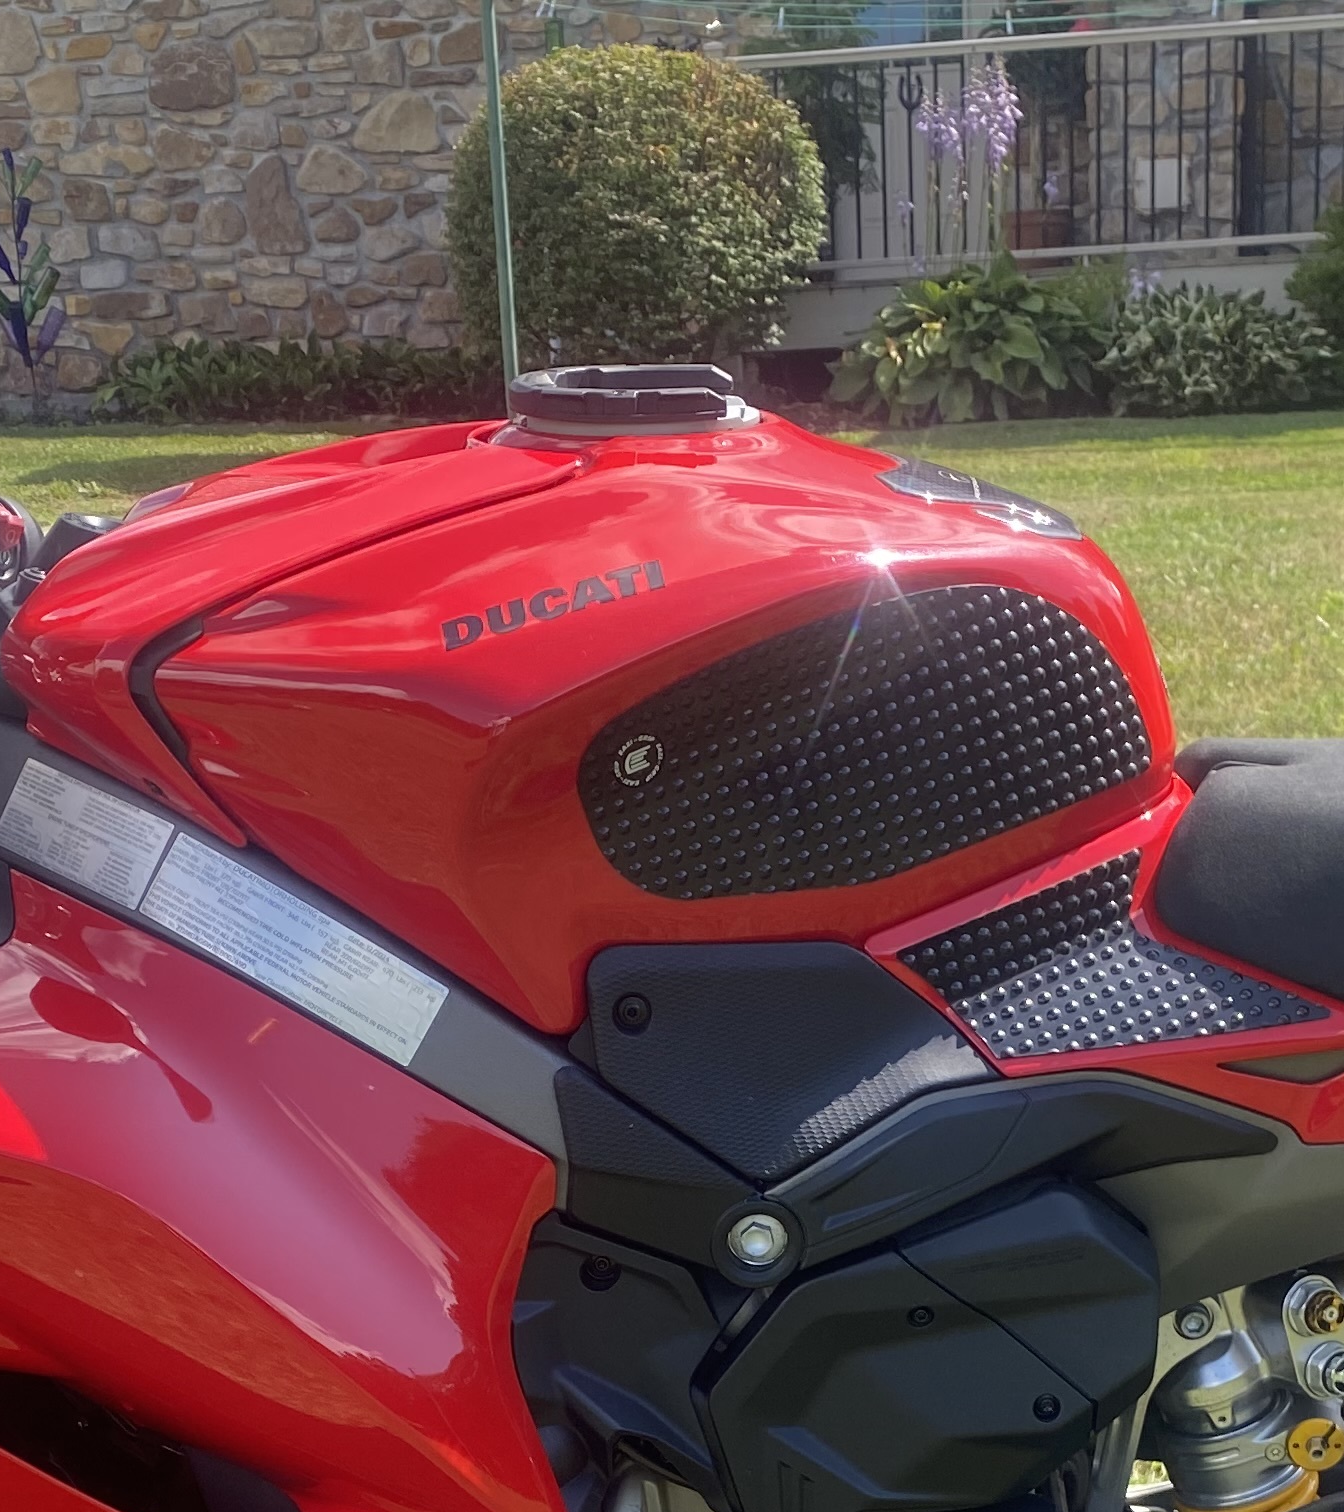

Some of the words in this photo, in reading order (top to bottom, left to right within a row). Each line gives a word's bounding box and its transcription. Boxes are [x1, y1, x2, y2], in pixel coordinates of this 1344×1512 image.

[442, 560, 666, 651] DUCATI
[218, 930, 231, 941] ALL
[272, 929, 290, 943] COLD
